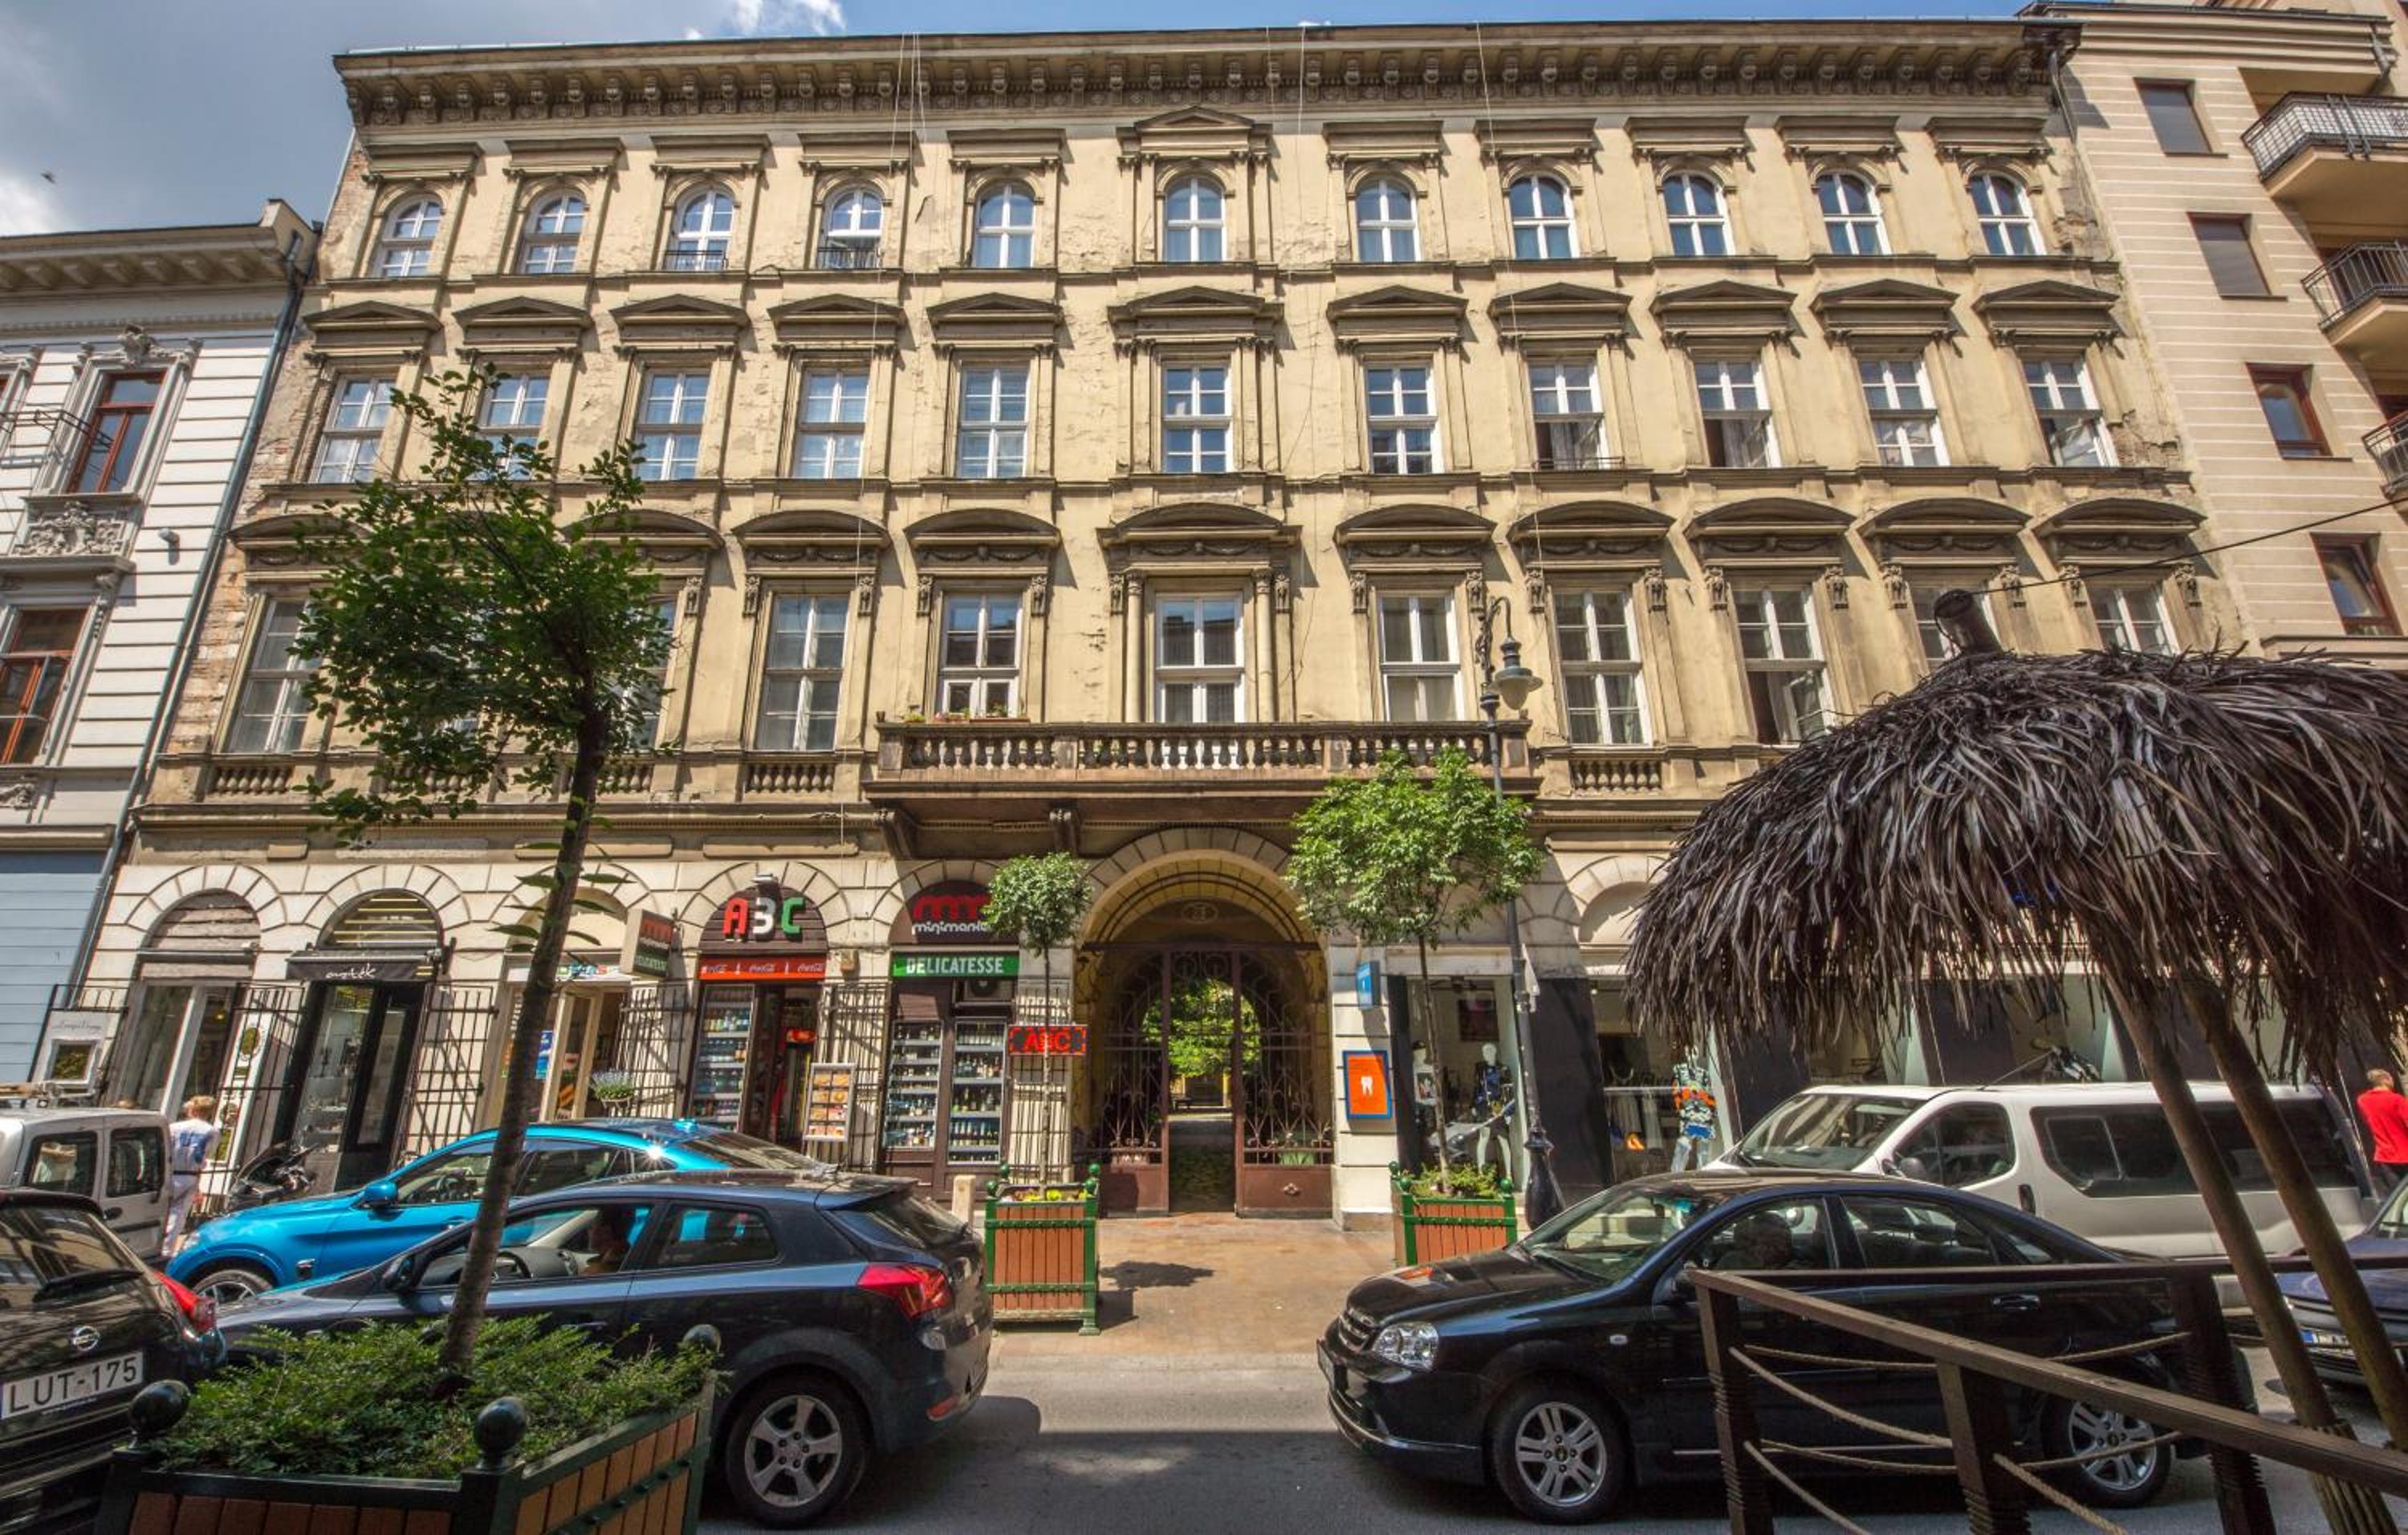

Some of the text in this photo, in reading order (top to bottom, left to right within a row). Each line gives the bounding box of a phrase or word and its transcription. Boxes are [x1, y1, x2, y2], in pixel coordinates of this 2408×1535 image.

[906, 956, 1004, 974] DELICATESSE
[1024, 1032, 1071, 1051] ABC
[10, 1357, 136, 1413] LUT-175
